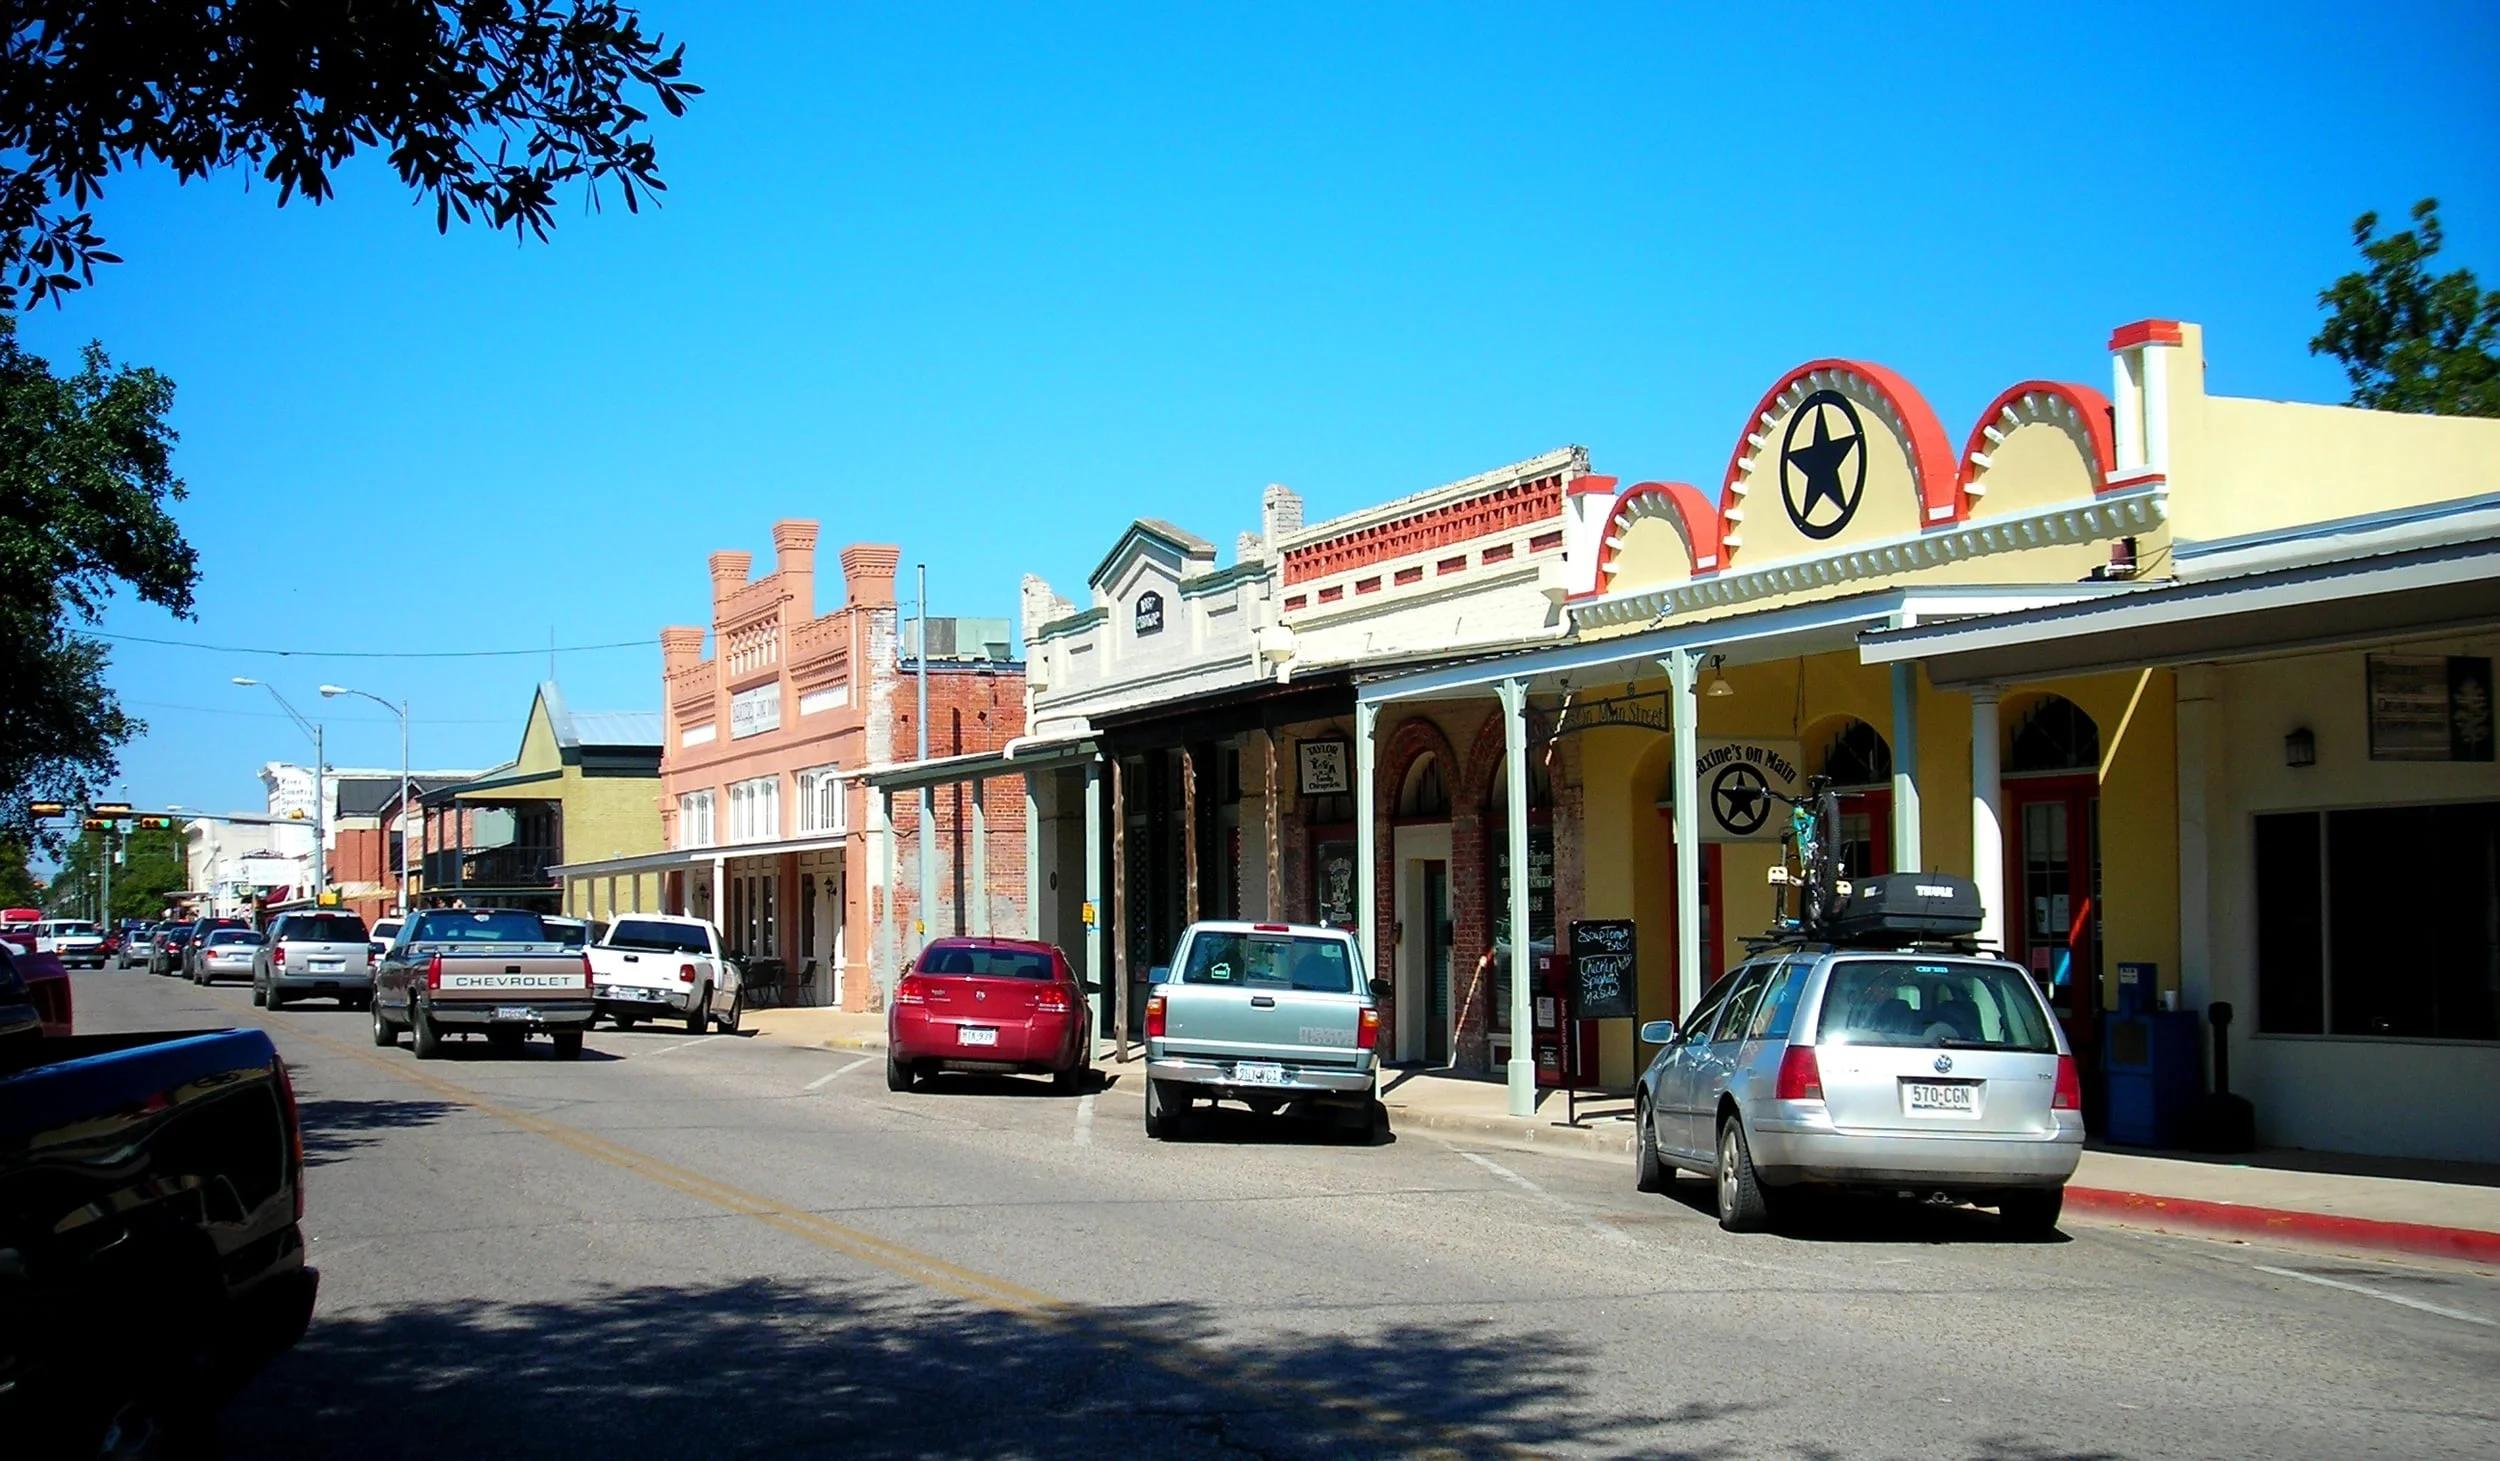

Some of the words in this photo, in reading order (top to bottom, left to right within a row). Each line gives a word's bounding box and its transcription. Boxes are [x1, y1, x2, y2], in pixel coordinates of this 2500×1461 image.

[1306, 744, 1339, 756] TAYLOR
[1696, 744, 1742, 779] axine's
[1745, 746, 1763, 764] on
[1764, 749, 1797, 785] Main
[456, 977, 571, 986] CHEVROLET
